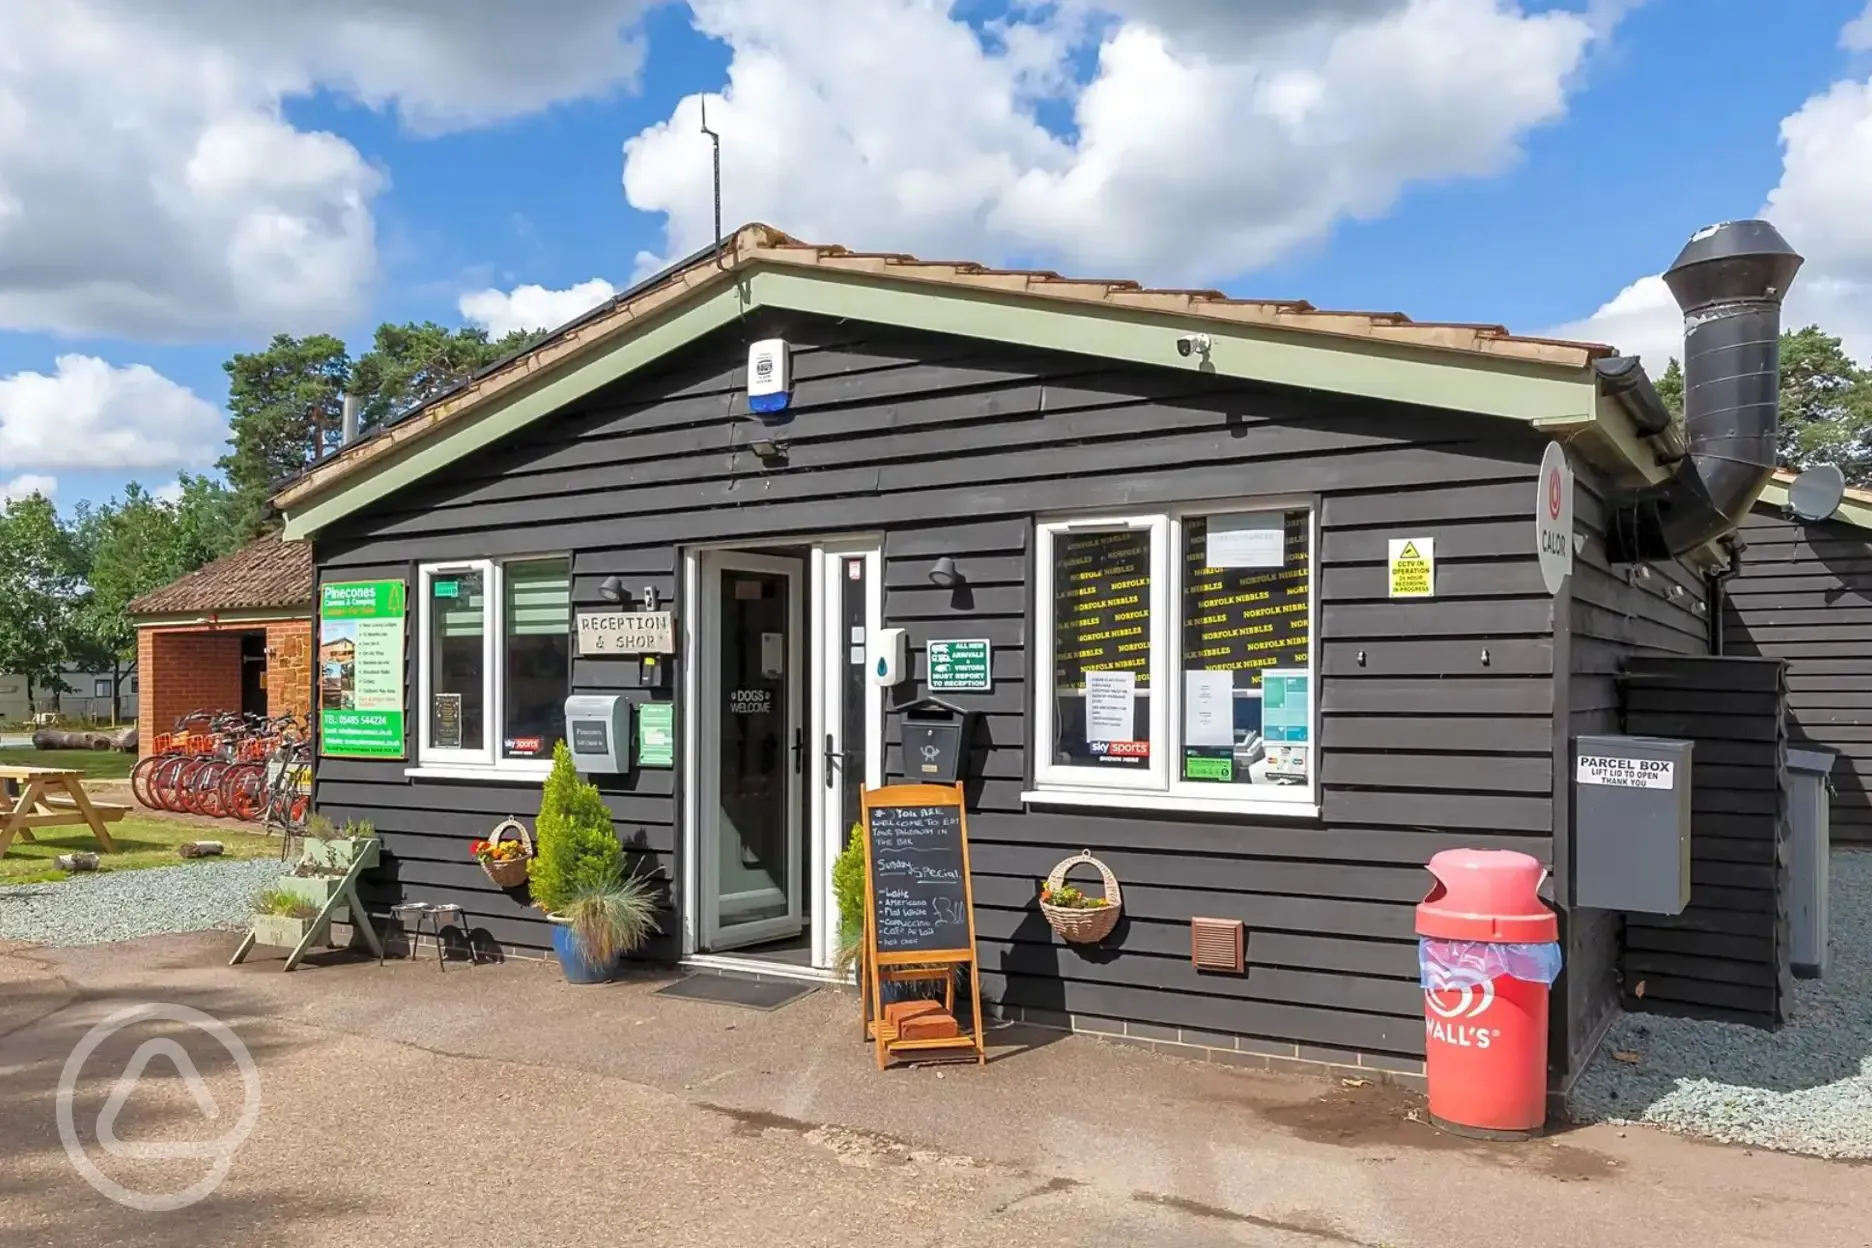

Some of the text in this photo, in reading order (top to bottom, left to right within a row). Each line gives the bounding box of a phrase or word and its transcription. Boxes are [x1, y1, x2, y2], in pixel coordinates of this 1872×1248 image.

[1542, 530, 1566, 557] CALOR
[1070, 564, 1134, 580] NORFOLK NIBBLES
[1111, 578, 1146, 590] NORFOLK
[1240, 574, 1276, 586] NORFOLK
[324, 587, 376, 601] Pinecones
[1067, 586, 1096, 598] NIBBLES
[1191, 582, 1223, 594] NIBBLES
[1074, 595, 1138, 612] NORFOLK NIBBLES
[1198, 591, 1270, 608] NORFOLK NIBBLES
[1114, 610, 1149, 622] NORFOLK
[1244, 606, 1282, 618] NORFOLK
[582, 617, 666, 630] RECEPTION
[1070, 616, 1100, 628] NIBBLES
[1194, 614, 1227, 627] NIBBLES
[1077, 626, 1142, 642] NORFOLK NIBBLES
[1202, 624, 1273, 640] NORFOLK NIBBLES
[596, 636, 654, 648] & SHOP
[1248, 638, 1286, 651] NORFOLK
[1073, 648, 1104, 659] NIBBLES
[1198, 646, 1231, 658] NIBBLES
[1080, 658, 1146, 672] NORFOLK NIBBLES
[1206, 656, 1278, 672] NORFOLK NIBBLES
[738, 690, 764, 701] DOGS
[730, 702, 770, 712] WELCOME
[504, 739, 539, 750] sky sports
[1092, 741, 1148, 753] sky sports
[1581, 757, 1670, 772] PARCEL BOX
[1602, 777, 1628, 786] THANK
[1636, 772, 1658, 780] OPEN
